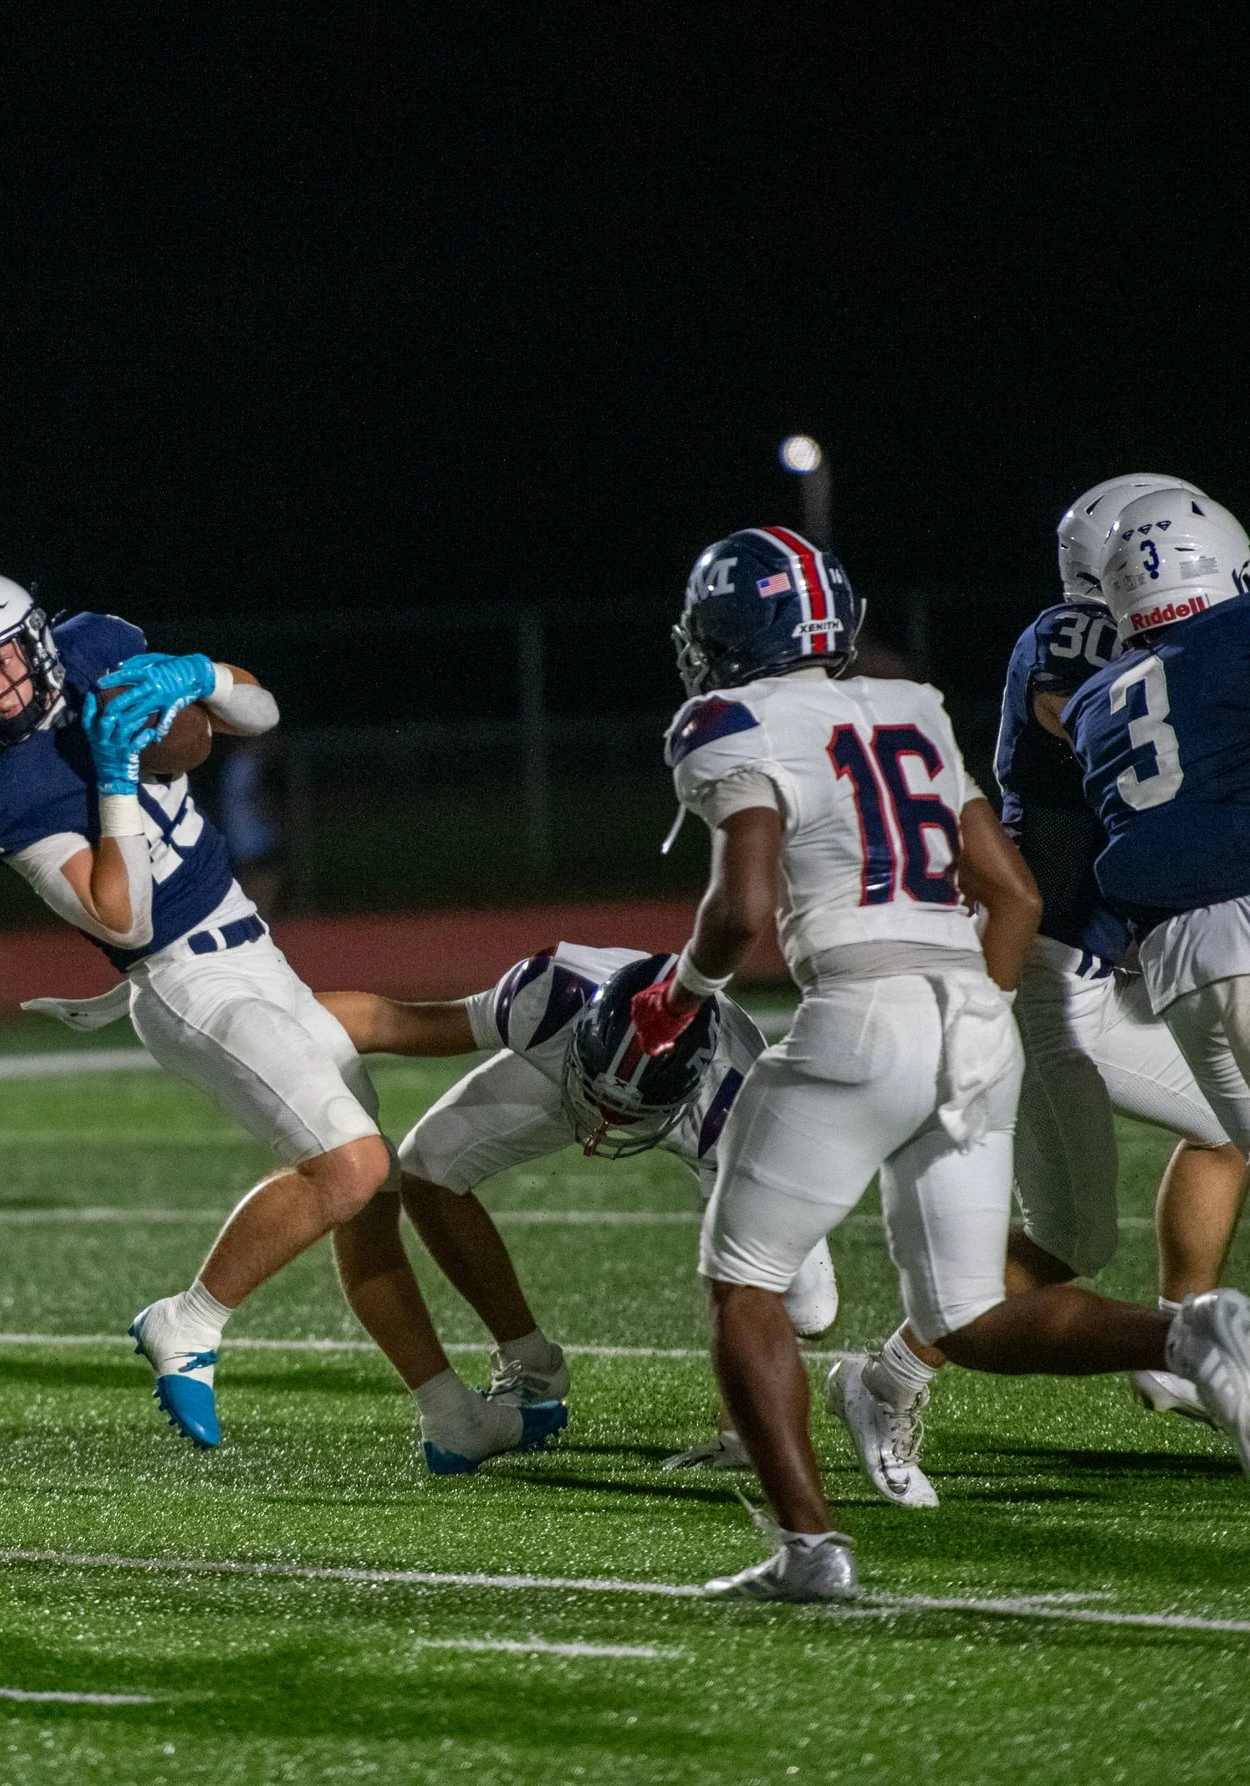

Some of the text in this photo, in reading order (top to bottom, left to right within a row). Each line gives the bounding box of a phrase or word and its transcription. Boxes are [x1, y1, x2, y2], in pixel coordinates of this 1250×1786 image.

[1139, 540, 1160, 572] 3
[800, 621, 840, 634] XENITH
[1130, 596, 1206, 632] Riddell
[1049, 611, 1124, 670] 30
[1109, 654, 1185, 811] 3
[826, 723, 964, 907] 16
